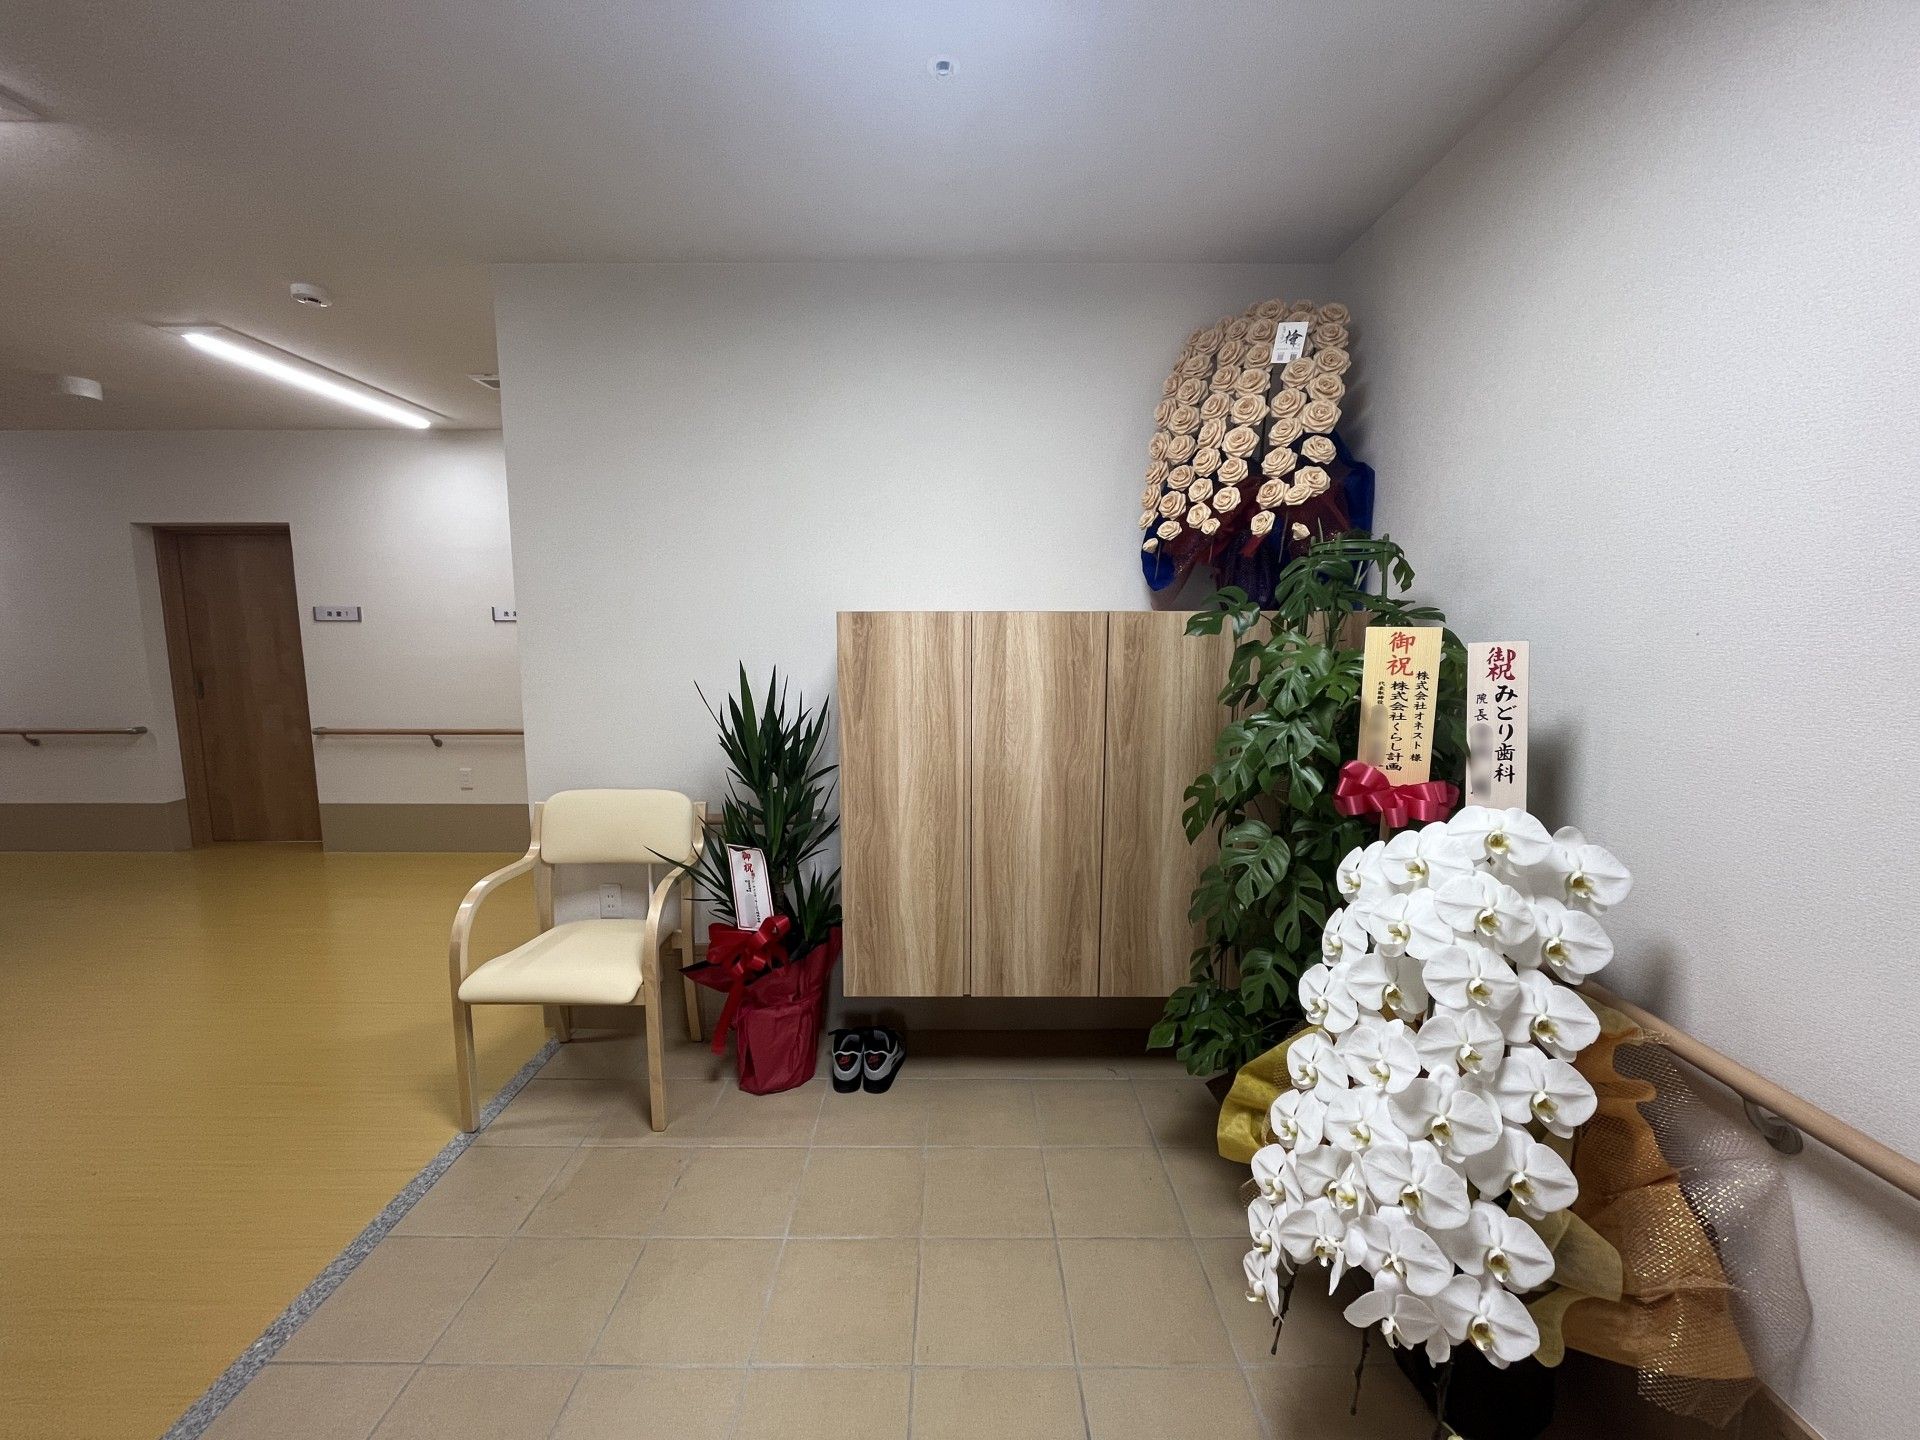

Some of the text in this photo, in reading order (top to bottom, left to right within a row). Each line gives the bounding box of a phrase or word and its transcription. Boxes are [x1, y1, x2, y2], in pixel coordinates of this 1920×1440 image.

[1386, 631, 1416, 677] 御祝
[1485, 646, 1517, 682] 御祝
[1386, 681, 1410, 771] 株式会社くらし計画
[1474, 692, 1489, 722] 院長
[1493, 684, 1518, 784] みどり歯科
